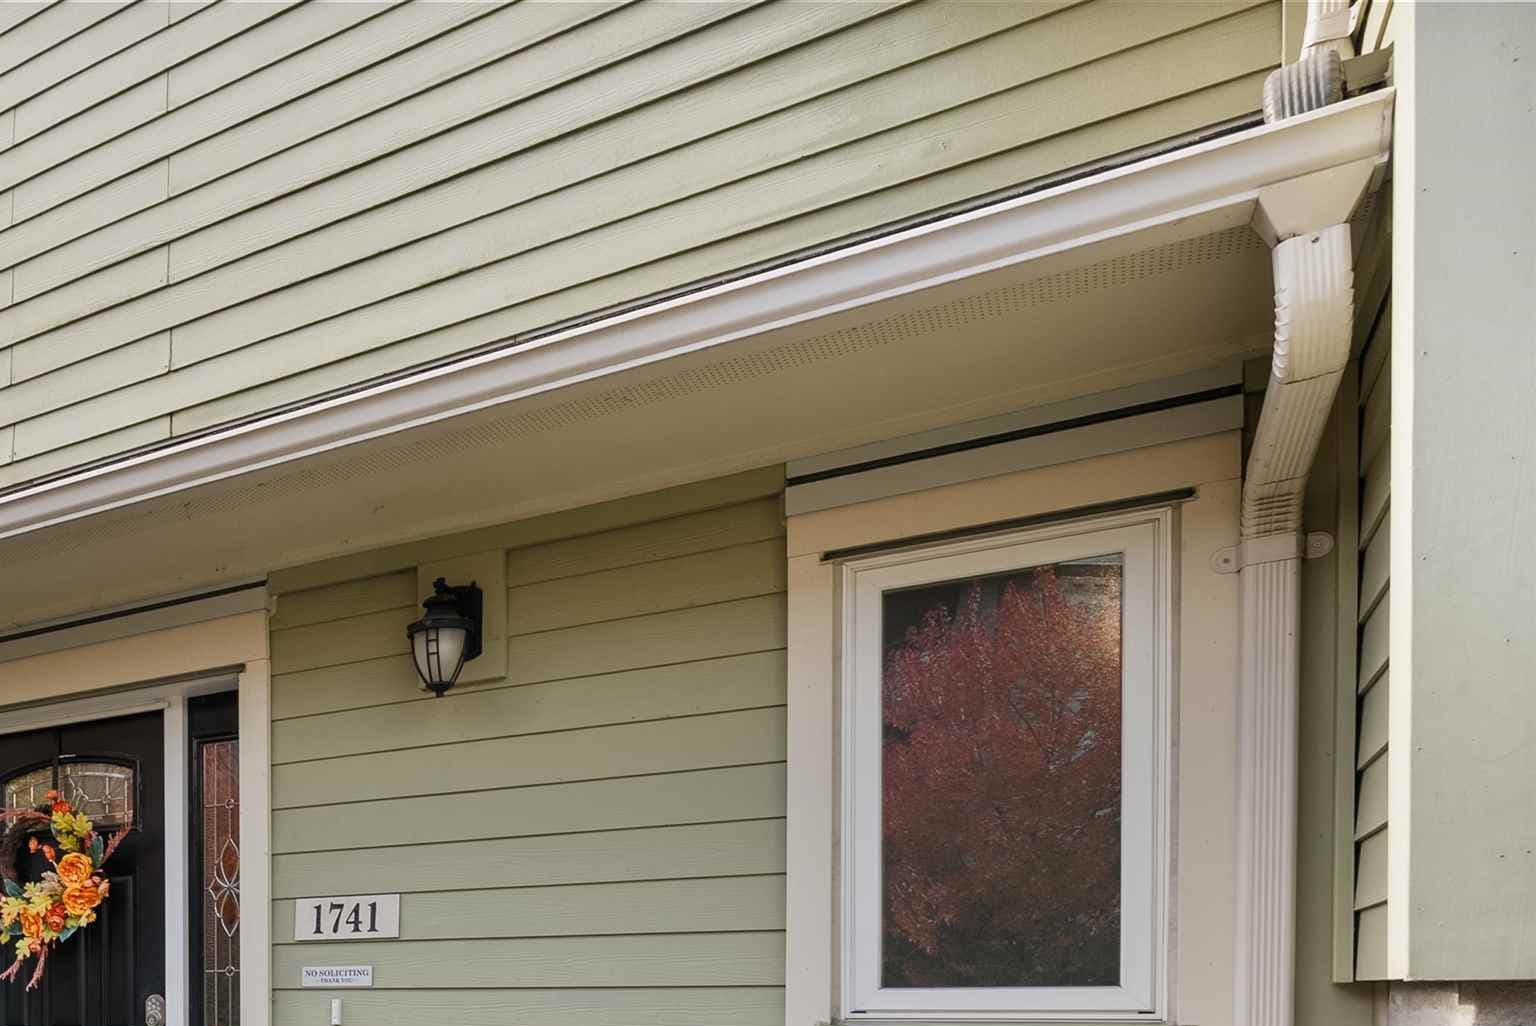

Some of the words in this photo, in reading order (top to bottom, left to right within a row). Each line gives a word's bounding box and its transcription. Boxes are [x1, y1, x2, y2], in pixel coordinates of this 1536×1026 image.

[312, 901, 379, 934] 1741
[305, 969, 318, 978] NO
[319, 968, 369, 977] SOLICITING
